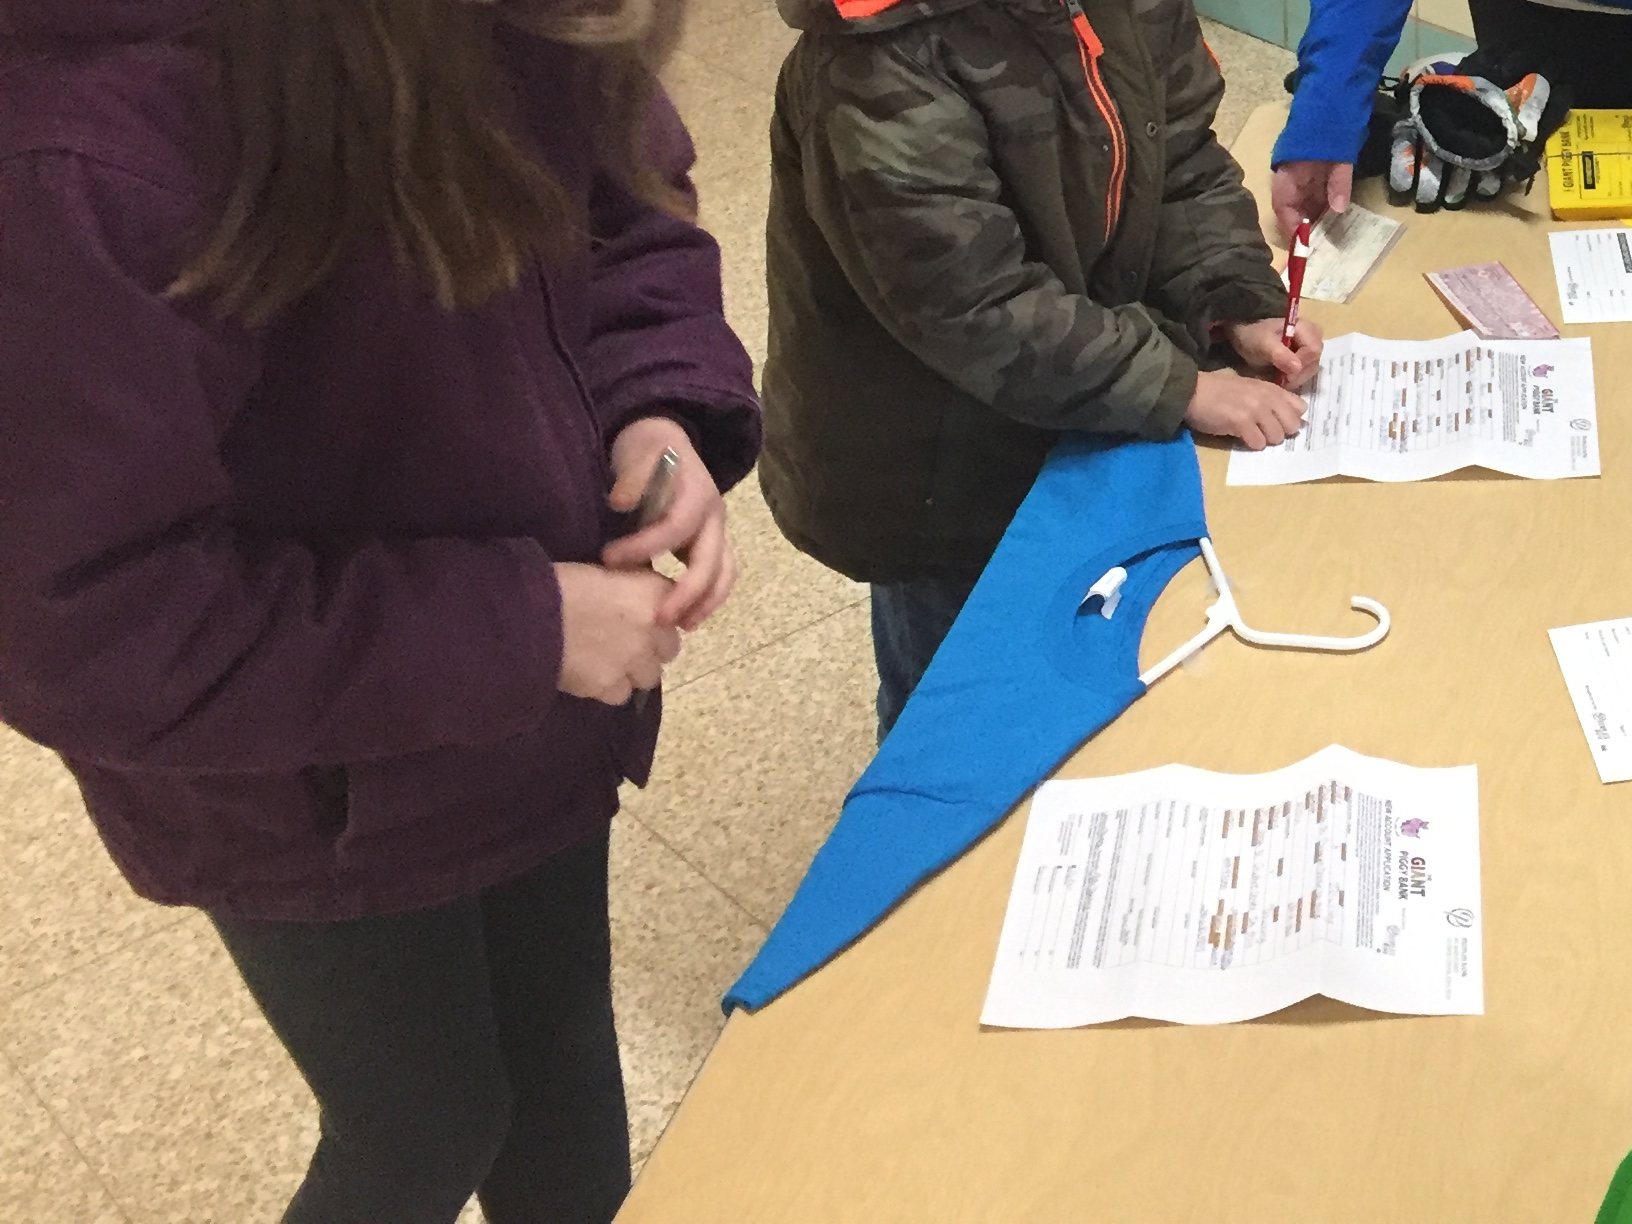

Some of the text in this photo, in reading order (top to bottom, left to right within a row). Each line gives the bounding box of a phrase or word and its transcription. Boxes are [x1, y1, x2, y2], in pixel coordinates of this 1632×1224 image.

[1398, 850, 1409, 900] PIGGY BANK
[1410, 856, 1426, 897] GIANT
